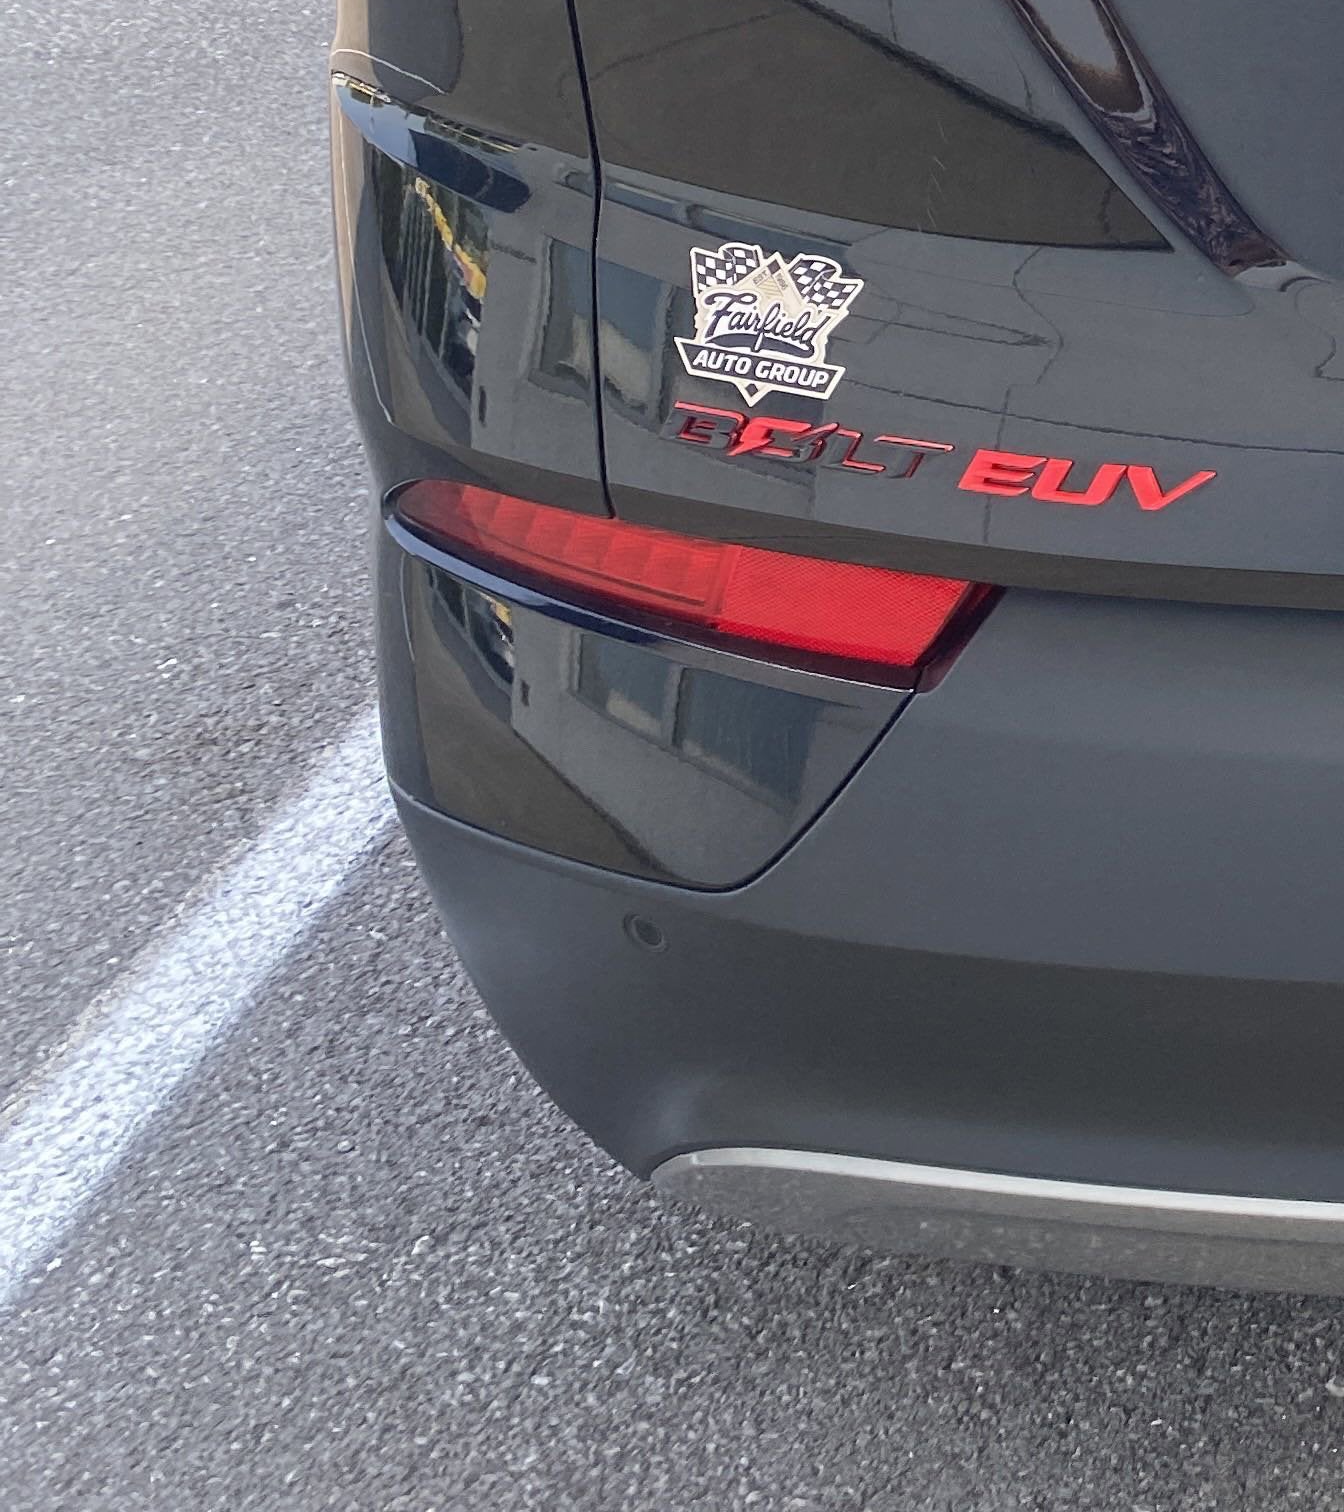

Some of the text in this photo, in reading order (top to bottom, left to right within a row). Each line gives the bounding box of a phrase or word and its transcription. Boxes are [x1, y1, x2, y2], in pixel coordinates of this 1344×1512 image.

[704, 292, 832, 345] Fairfield
[693, 350, 829, 388] AUTO GROUP
[661, 400, 1217, 511] BOLT EUV
